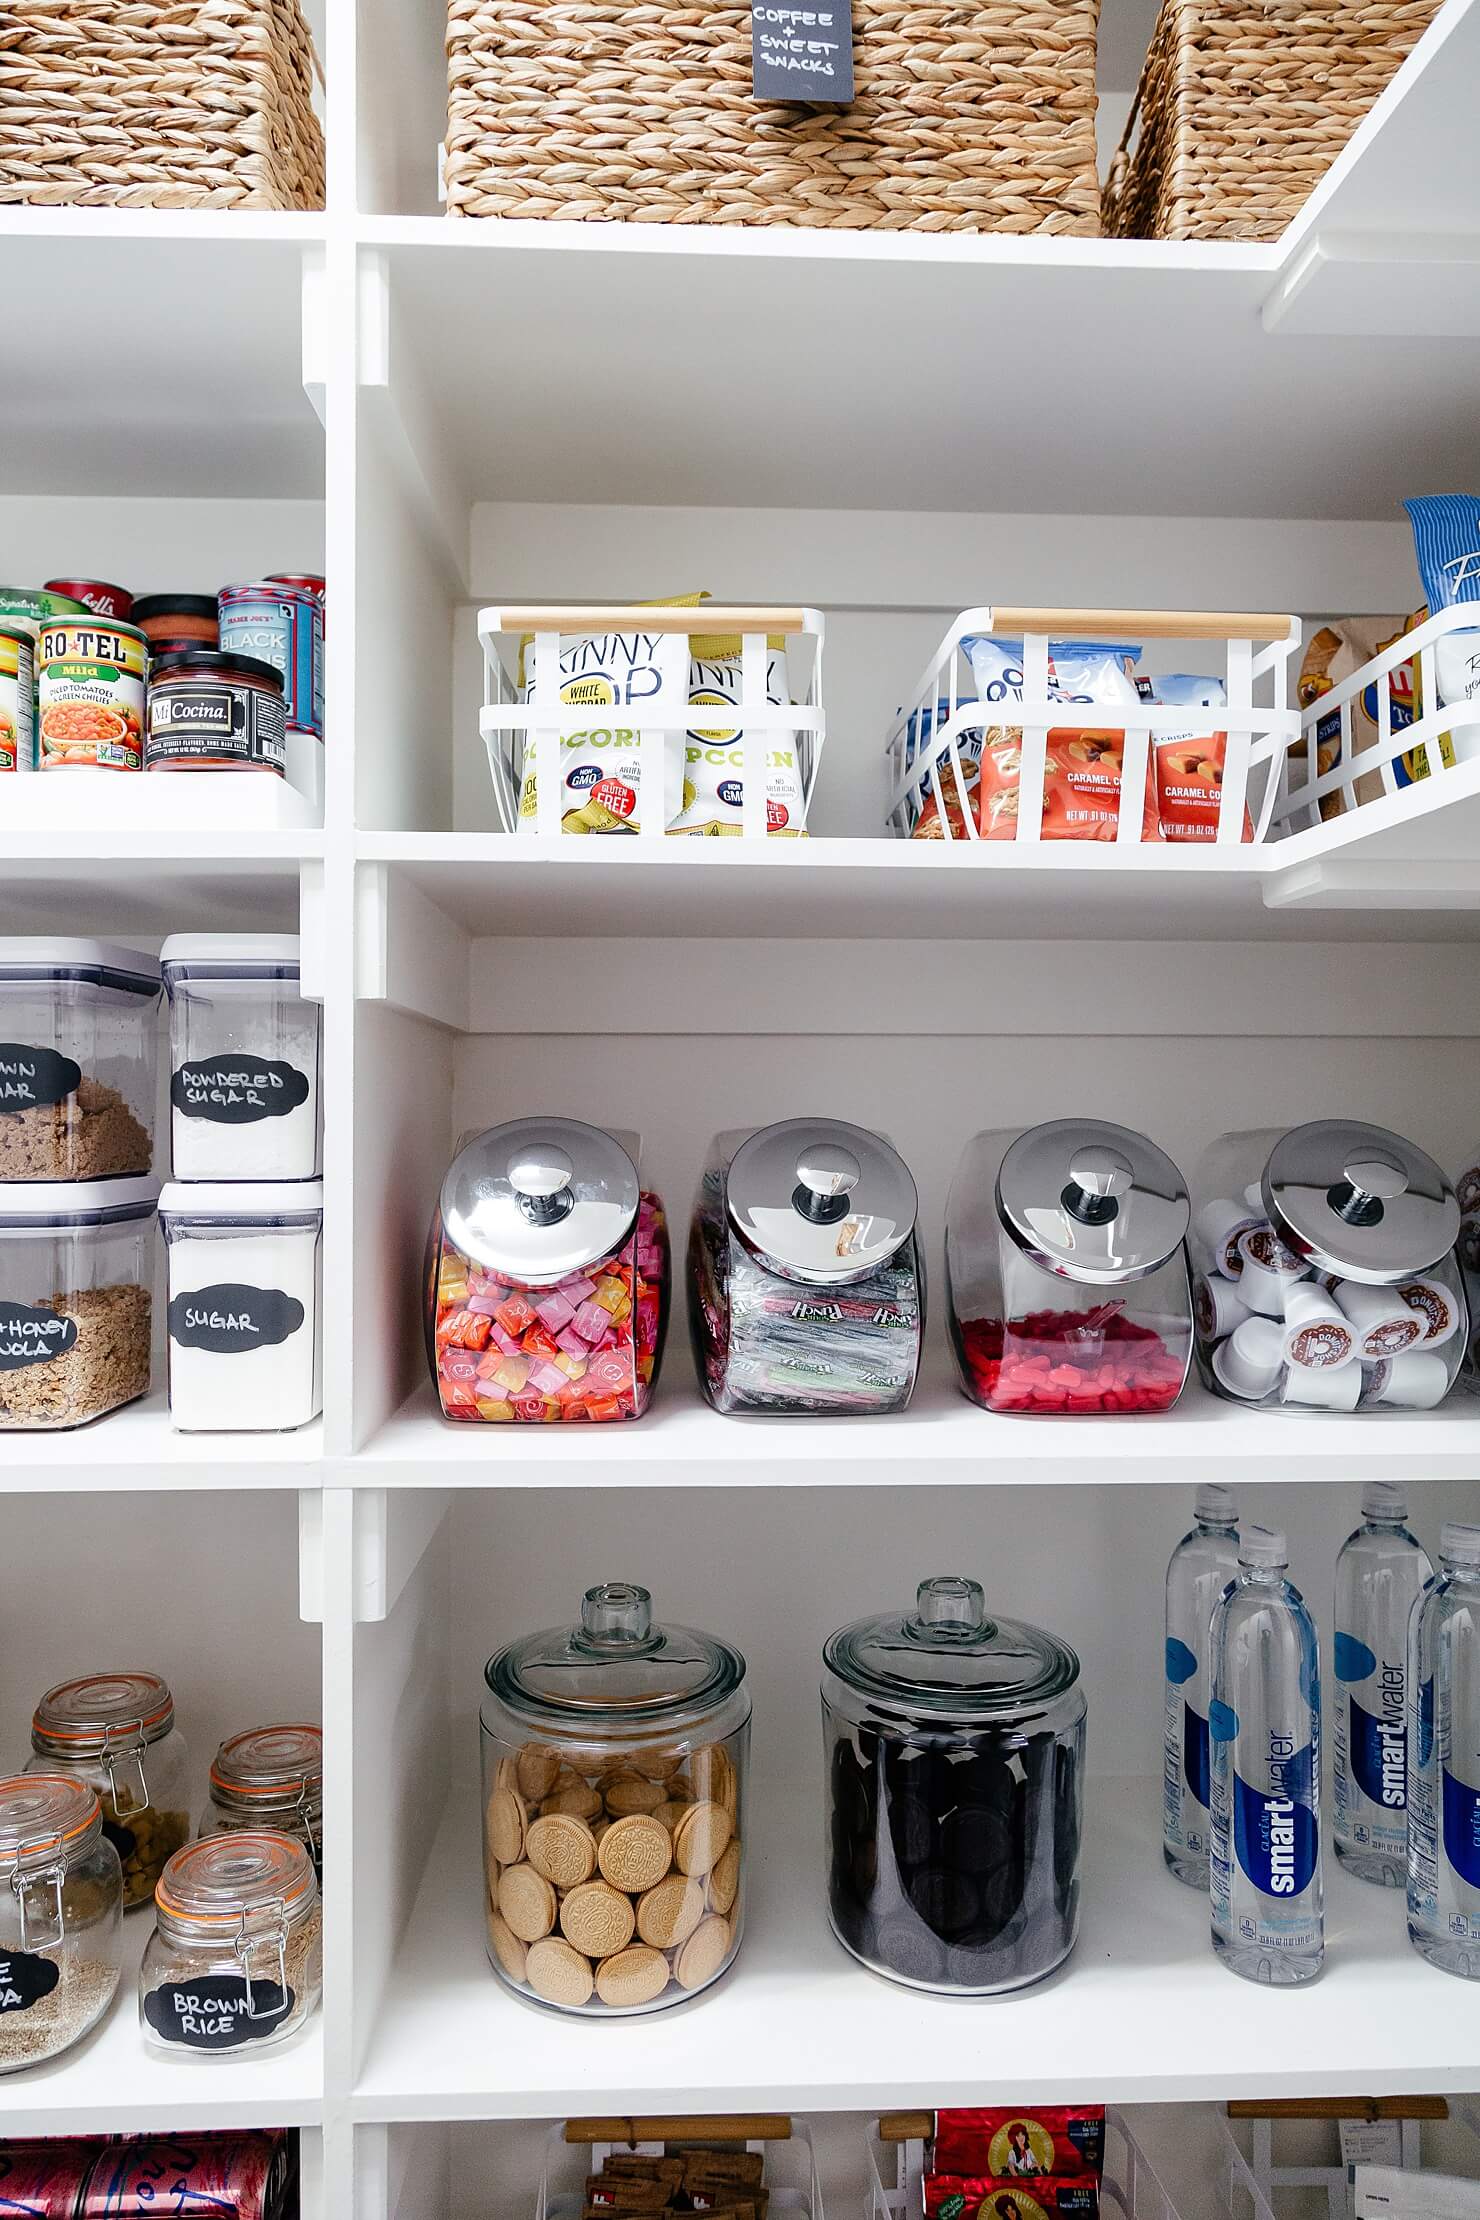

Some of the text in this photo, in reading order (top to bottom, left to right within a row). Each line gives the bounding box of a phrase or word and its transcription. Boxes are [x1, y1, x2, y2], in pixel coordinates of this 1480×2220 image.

[752, 6, 833, 26] COFFEE
[782, 26, 795, 37] +
[759, 34, 839, 56] SWEET
[760, 52, 834, 76] SNACKS
[221, 632, 286, 650] BLACK
[62, 665, 98, 676] Mild
[58, 692, 81, 702] GREEN
[81, 691, 110, 705] CHILIES
[69, 684, 113, 698] TOMATOES
[570, 684, 601, 699] WHITE
[1161, 732, 1194, 742] CRISPS
[571, 773, 598, 786] GMO
[1067, 772, 1111, 786] CARAMEL
[601, 784, 628, 797] GLUTEN
[1165, 786, 1207, 799] CARAMEL
[597, 792, 630, 817] FREE
[182, 1069, 284, 1088] POWDERED
[186, 1087, 266, 1106] SUGAR
[185, 1308, 260, 1332] SUGAR
[173, 1992, 256, 2014] BROWN
[182, 2015, 234, 2035] RICE
